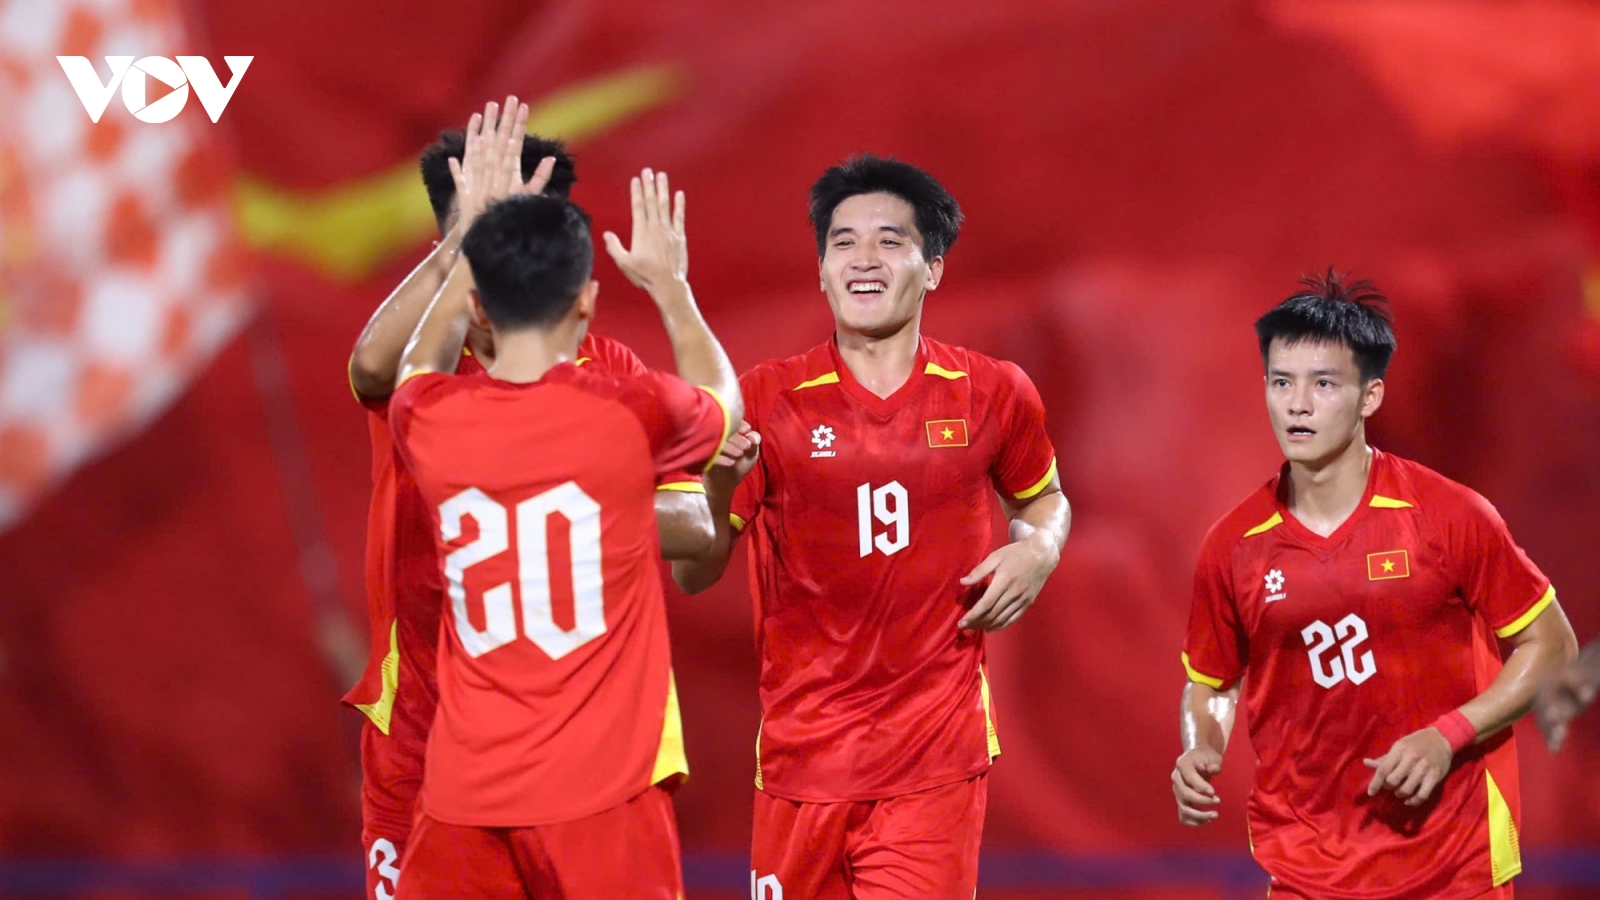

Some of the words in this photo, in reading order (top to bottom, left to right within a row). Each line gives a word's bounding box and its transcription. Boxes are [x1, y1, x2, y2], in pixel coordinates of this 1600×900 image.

[857, 481, 909, 557] 19
[439, 481, 606, 659] 20
[1301, 613, 1376, 688] 22
